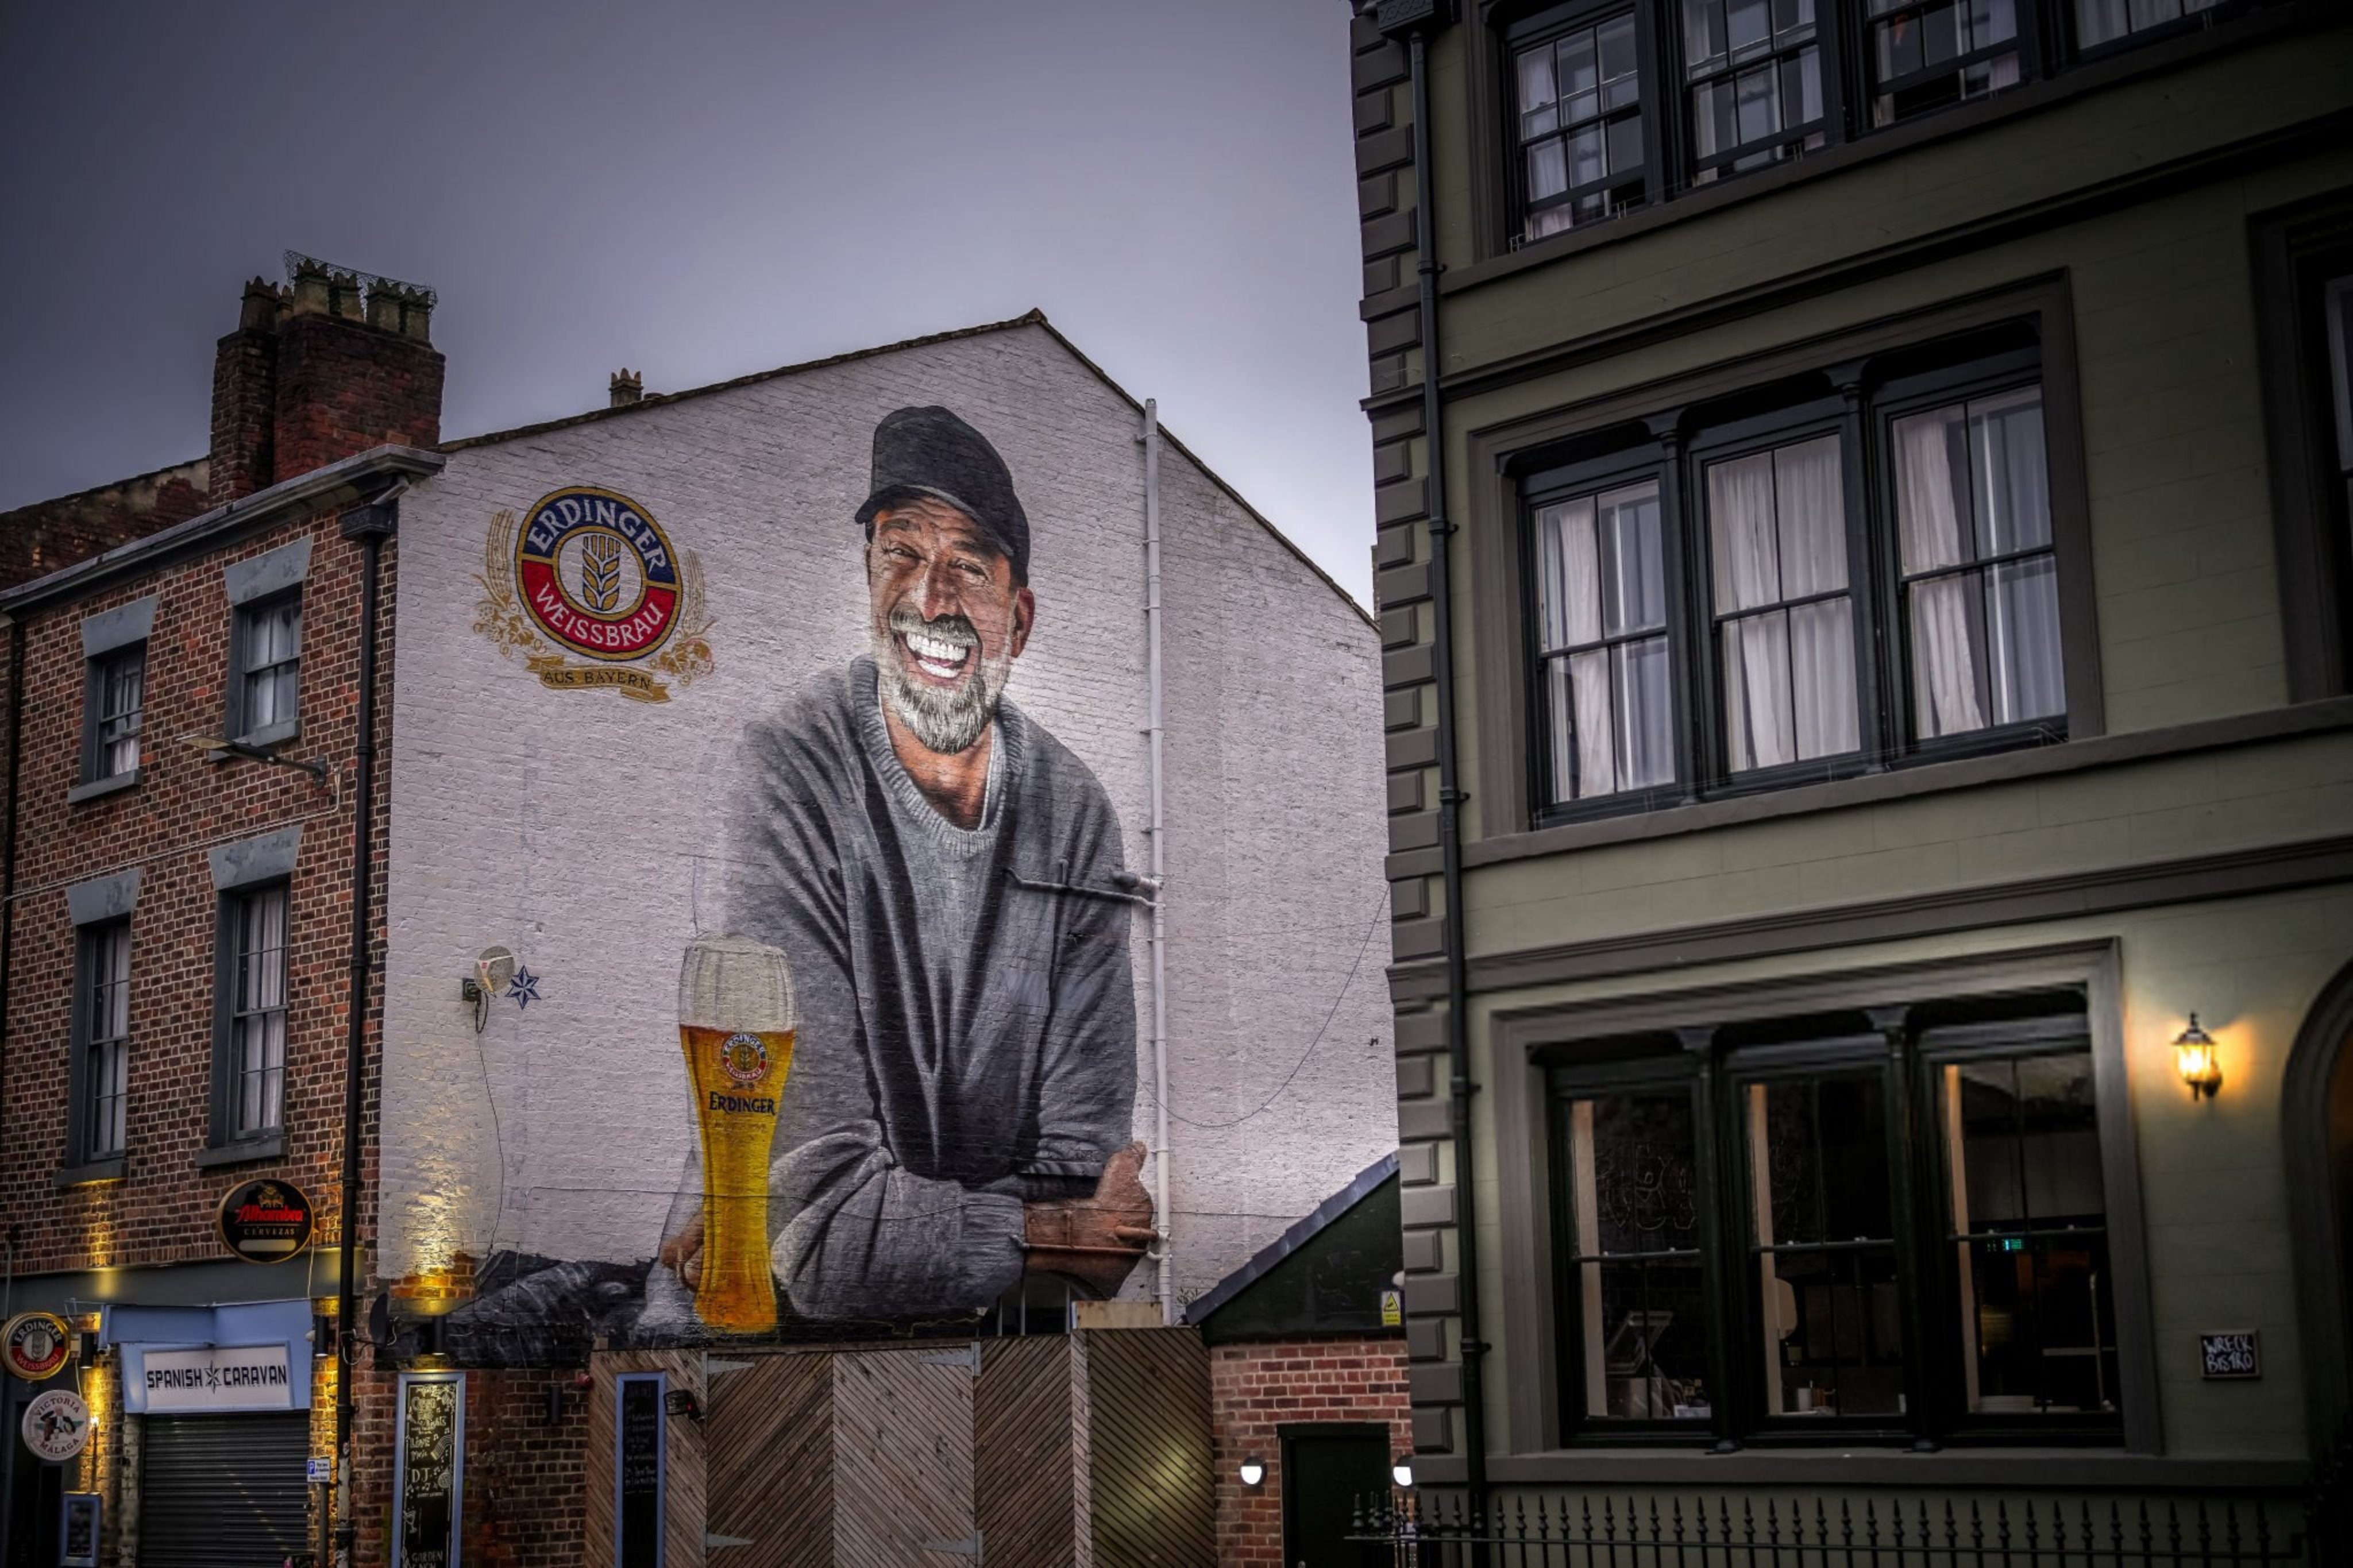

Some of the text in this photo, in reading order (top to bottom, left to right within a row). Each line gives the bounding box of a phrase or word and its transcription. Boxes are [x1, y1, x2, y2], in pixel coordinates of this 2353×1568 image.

[529, 497, 667, 574] ERDINGER
[543, 670, 651, 690] AUS BAYERN
[709, 1091, 776, 1116] ERDINGER
[234, 1203, 304, 1223] Alhambra
[244, 1227, 295, 1236] CERVEZAS
[14, 1320, 63, 1343] ERDINGER
[2202, 1334, 2252, 1353] WRECK
[2205, 1351, 2253, 1373] BISTRO
[146, 1365, 287, 1389] SPANISH CARAVAN
[36, 1396, 80, 1416] VICTORIA
[309, 1462, 314, 1473] P
[411, 1550, 443, 1563] GARDEN
